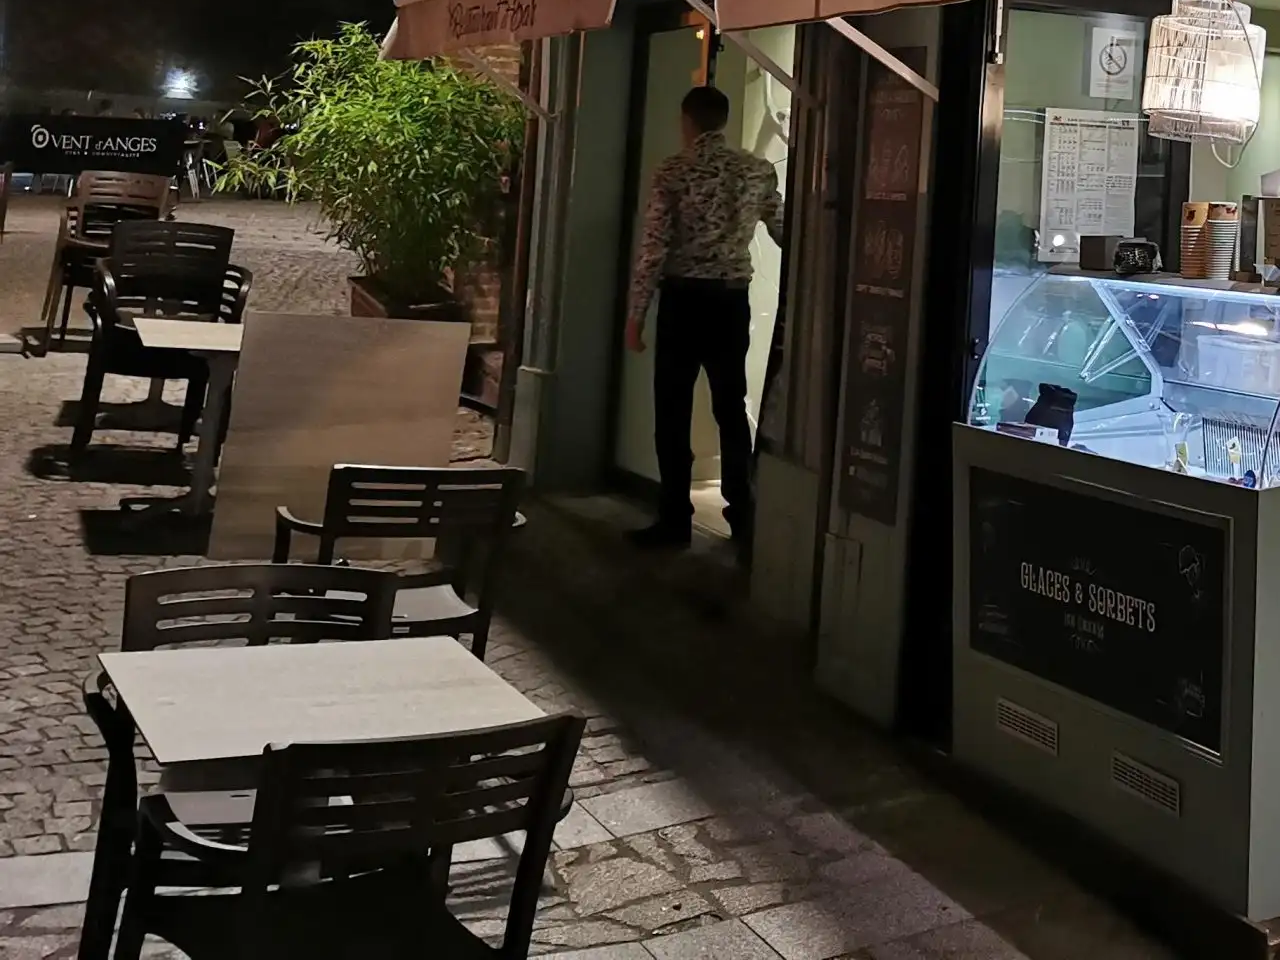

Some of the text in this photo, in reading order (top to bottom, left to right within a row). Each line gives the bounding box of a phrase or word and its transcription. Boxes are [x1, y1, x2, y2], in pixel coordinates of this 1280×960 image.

[1020, 561, 1070, 603] GLACES
[1075, 582, 1083, 604] &
[1088, 583, 1156, 632] SORBETS
